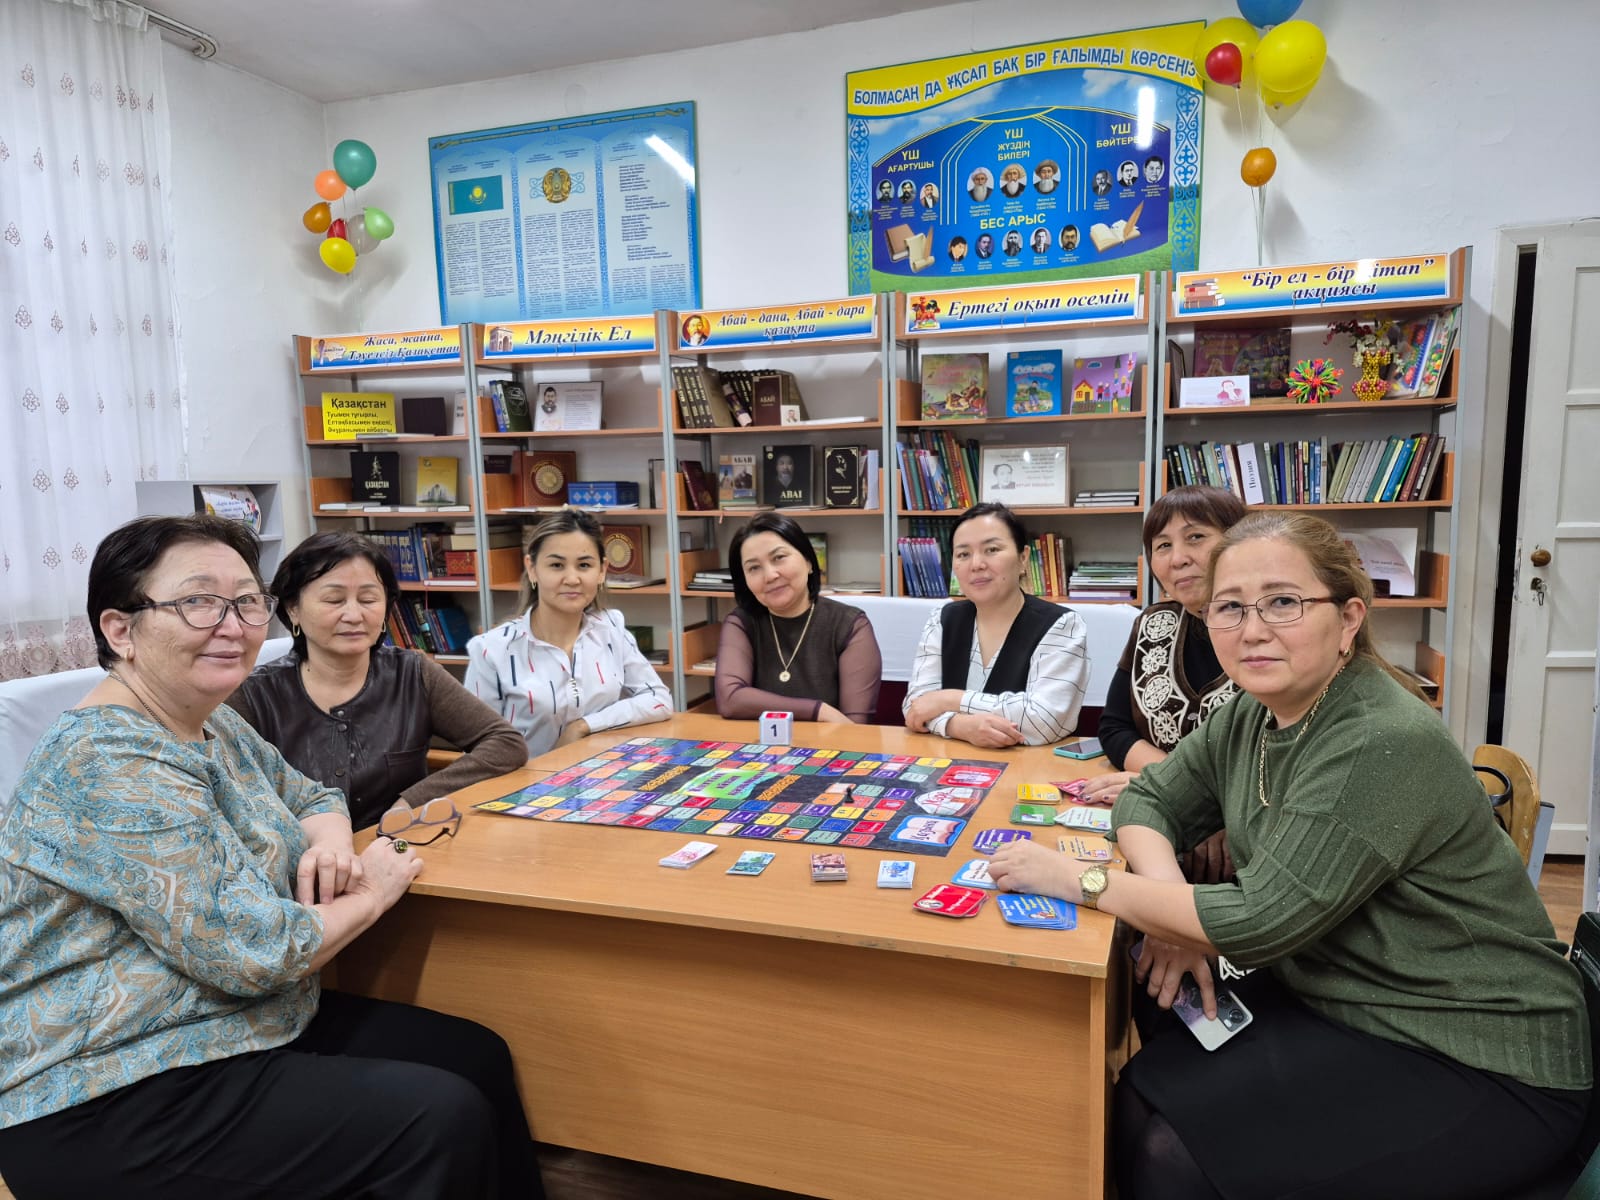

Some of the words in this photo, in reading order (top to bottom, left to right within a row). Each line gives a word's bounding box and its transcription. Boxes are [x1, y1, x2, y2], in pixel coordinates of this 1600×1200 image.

[854, 86, 920, 105] БОЛМАСАҢ
[925, 81, 942, 98] ДА
[947, 64, 987, 88] ҰҚСАП
[994, 57, 1018, 74] БАҚ
[1025, 52, 1046, 68] БІР
[1053, 48, 1124, 66] ҒАЛЫМДЫ
[1004, 128, 1023, 139] ҮШ
[1111, 123, 1131, 135] ҮШ
[1096, 136, 1140, 148] БӘЙТЕРЕ
[901, 150, 920, 161] ҮШ
[997, 151, 1030, 161] БИЛЕРІ
[887, 161, 935, 174] АҒАРТУШЫ
[980, 217, 1005, 230] БЕС
[1008, 213, 1046, 226] АРЫС
[1287, 273, 1307, 284] ел
[1326, 266, 1355, 284] бір
[1293, 283, 1377, 300] акциясы
[948, 297, 1010, 320] Ертегі
[1014, 296, 1061, 312] оқып
[1066, 288, 1130, 307] өсемін
[718, 315, 747, 327] Абай
[758, 313, 790, 324] дана,
[793, 308, 825, 321] Абай
[836, 305, 866, 319] дара
[525, 328, 603, 347] Мәңгілік
[608, 326, 632, 341] Ел
[763, 323, 816, 338] қазақта
[331, 398, 387, 410] Қазақстан
[770, 724, 778, 737] 1
